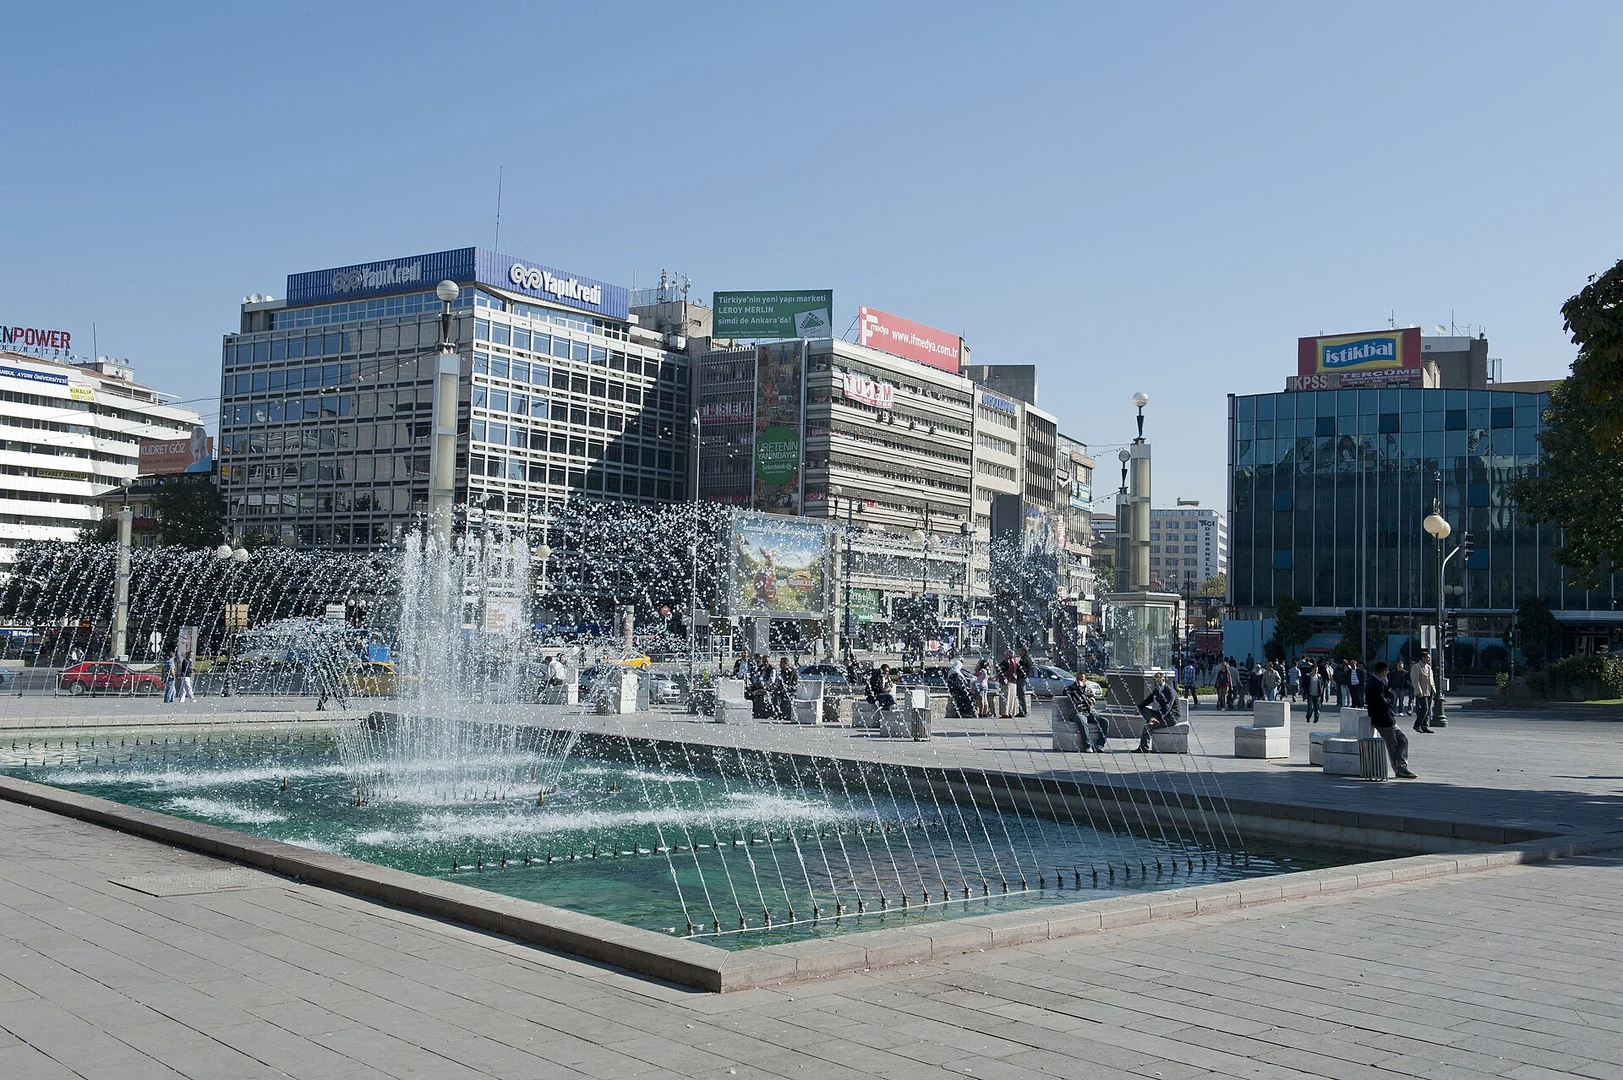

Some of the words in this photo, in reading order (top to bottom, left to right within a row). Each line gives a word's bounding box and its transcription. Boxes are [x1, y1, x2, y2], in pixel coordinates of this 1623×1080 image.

[718, 296, 760, 304] Türkiye'nin
[762, 296, 778, 304] yeni
[779, 296, 795, 304] yapı
[797, 295, 826, 303] marketi
[744, 306, 774, 314] MERLIN
[718, 317, 738, 325] şimdi
[750, 316, 792, 324] Ankara'da!
[0, 326, 71, 349] NPOWER
[870, 323, 889, 335] medya
[892, 330, 958, 358] www.ifmedya.com.tr
[1326, 343, 1393, 363] istikbal
[1340, 369, 1421, 379] TERCÜME
[1293, 375, 1328, 390] KPSS
[140, 443, 169, 456] KUDRET
[169, 441, 186, 454] GÖZ
[756, 439, 798, 452] ÜRETENİN
